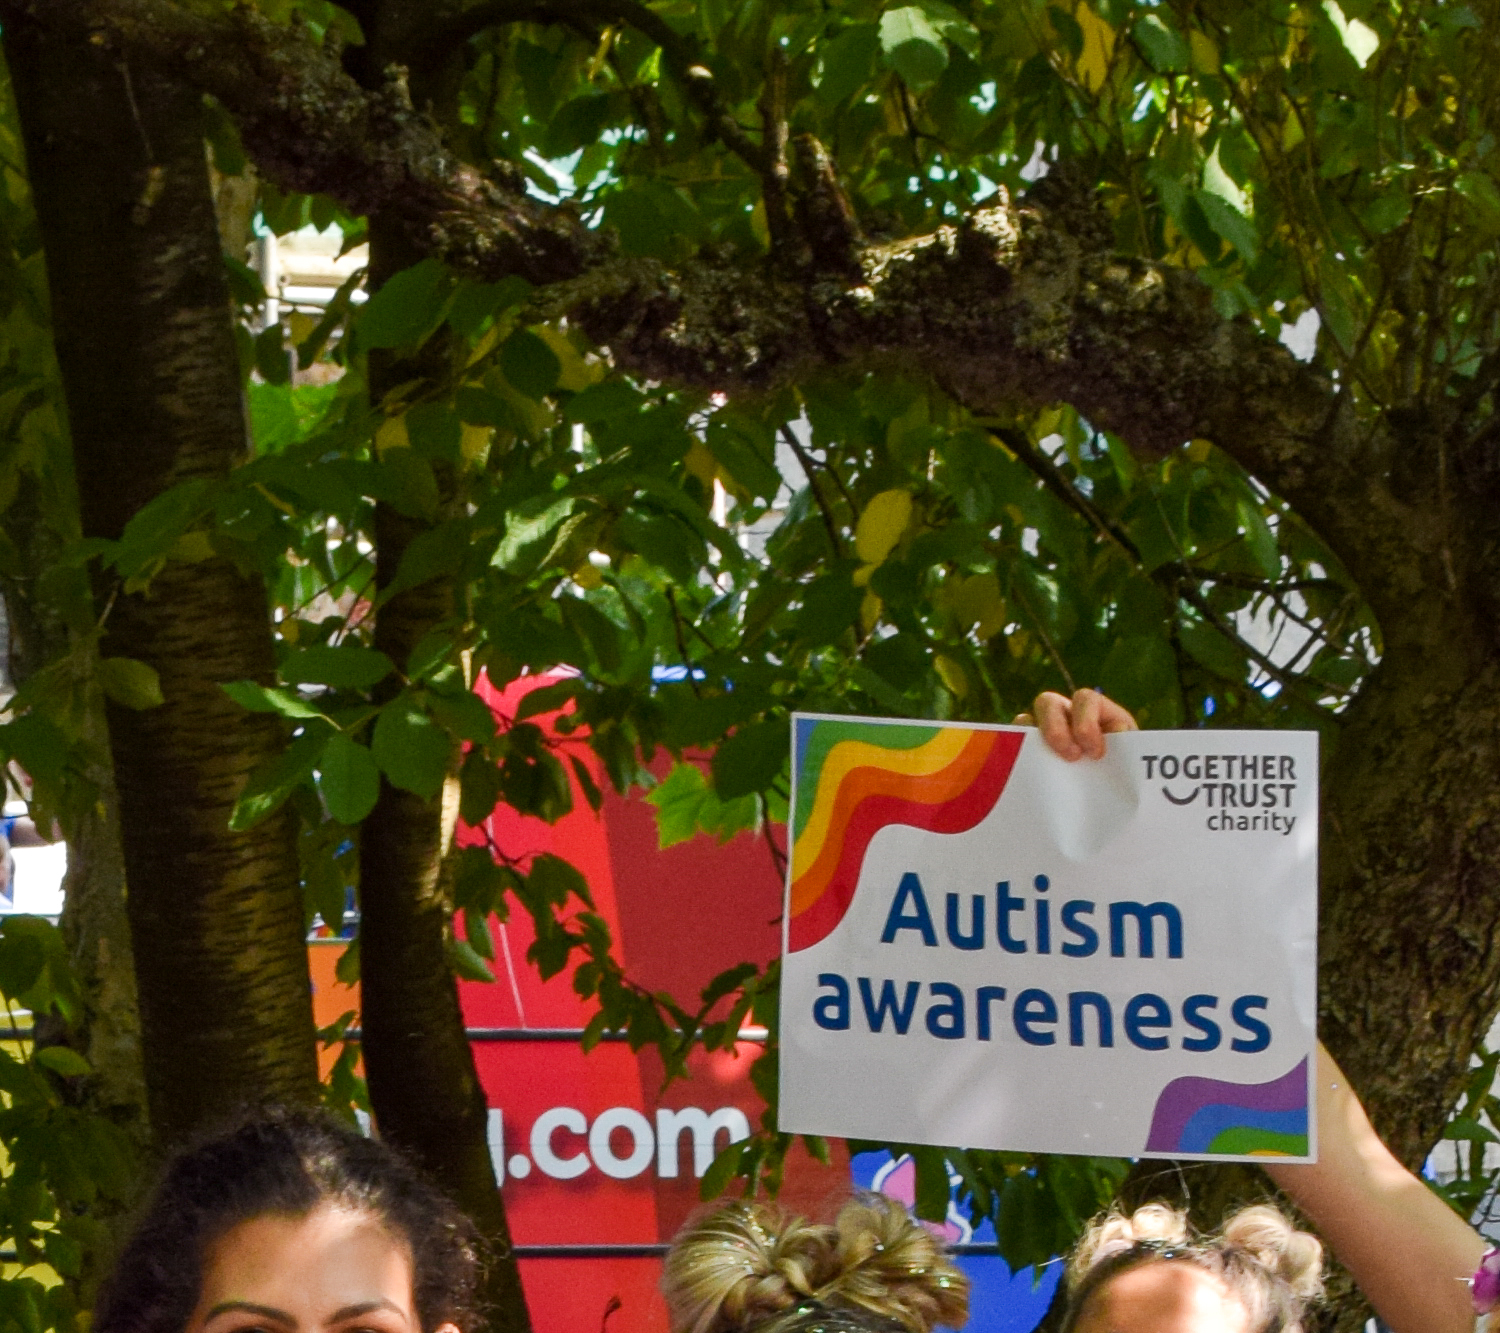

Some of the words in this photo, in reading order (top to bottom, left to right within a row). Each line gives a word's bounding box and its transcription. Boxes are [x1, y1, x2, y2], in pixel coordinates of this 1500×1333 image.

[1142, 754, 1297, 782] TOGETHER
[1203, 781, 1296, 809] TRUST
[1207, 808, 1297, 837] charity
[880, 871, 1184, 961] Autism
[812, 972, 1273, 1055] awareness
